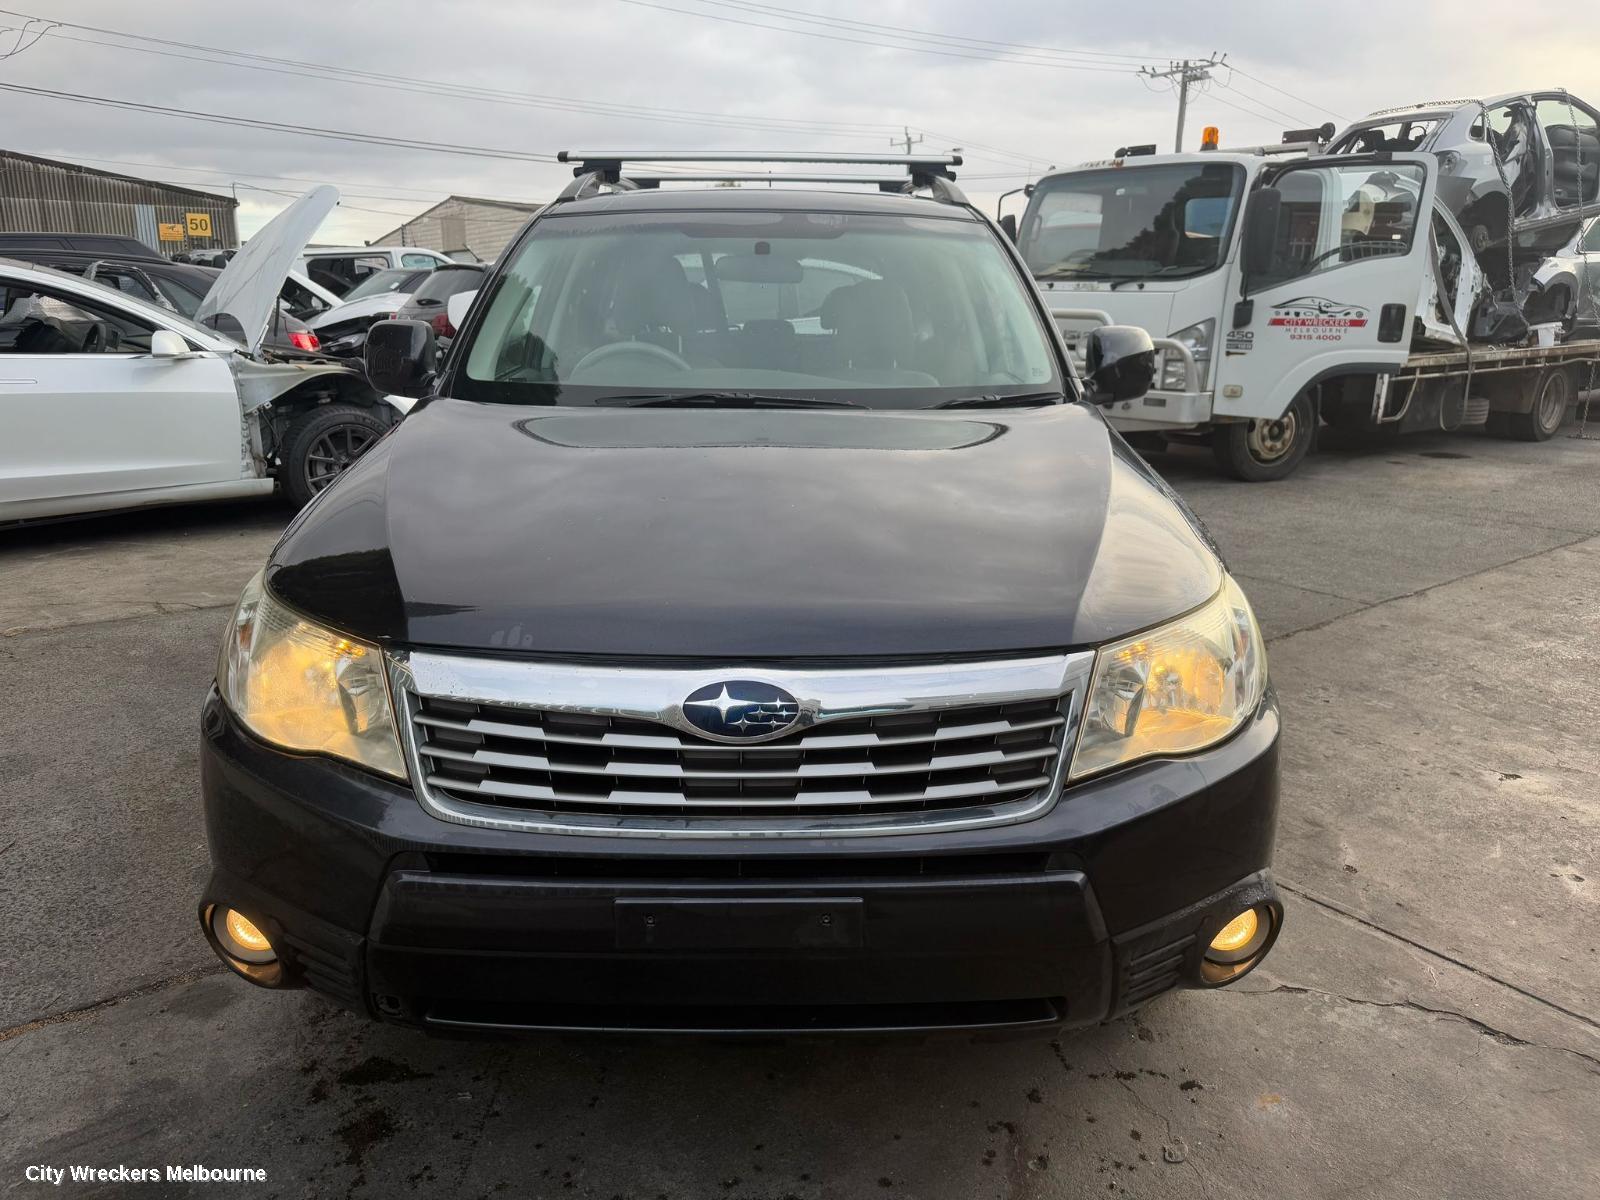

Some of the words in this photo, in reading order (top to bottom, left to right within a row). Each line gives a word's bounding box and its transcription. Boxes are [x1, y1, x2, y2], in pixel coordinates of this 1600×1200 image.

[190, 218, 208, 232] 50
[1305, 319, 1350, 327] WRECKERS
[1226, 331, 1254, 339] 450
